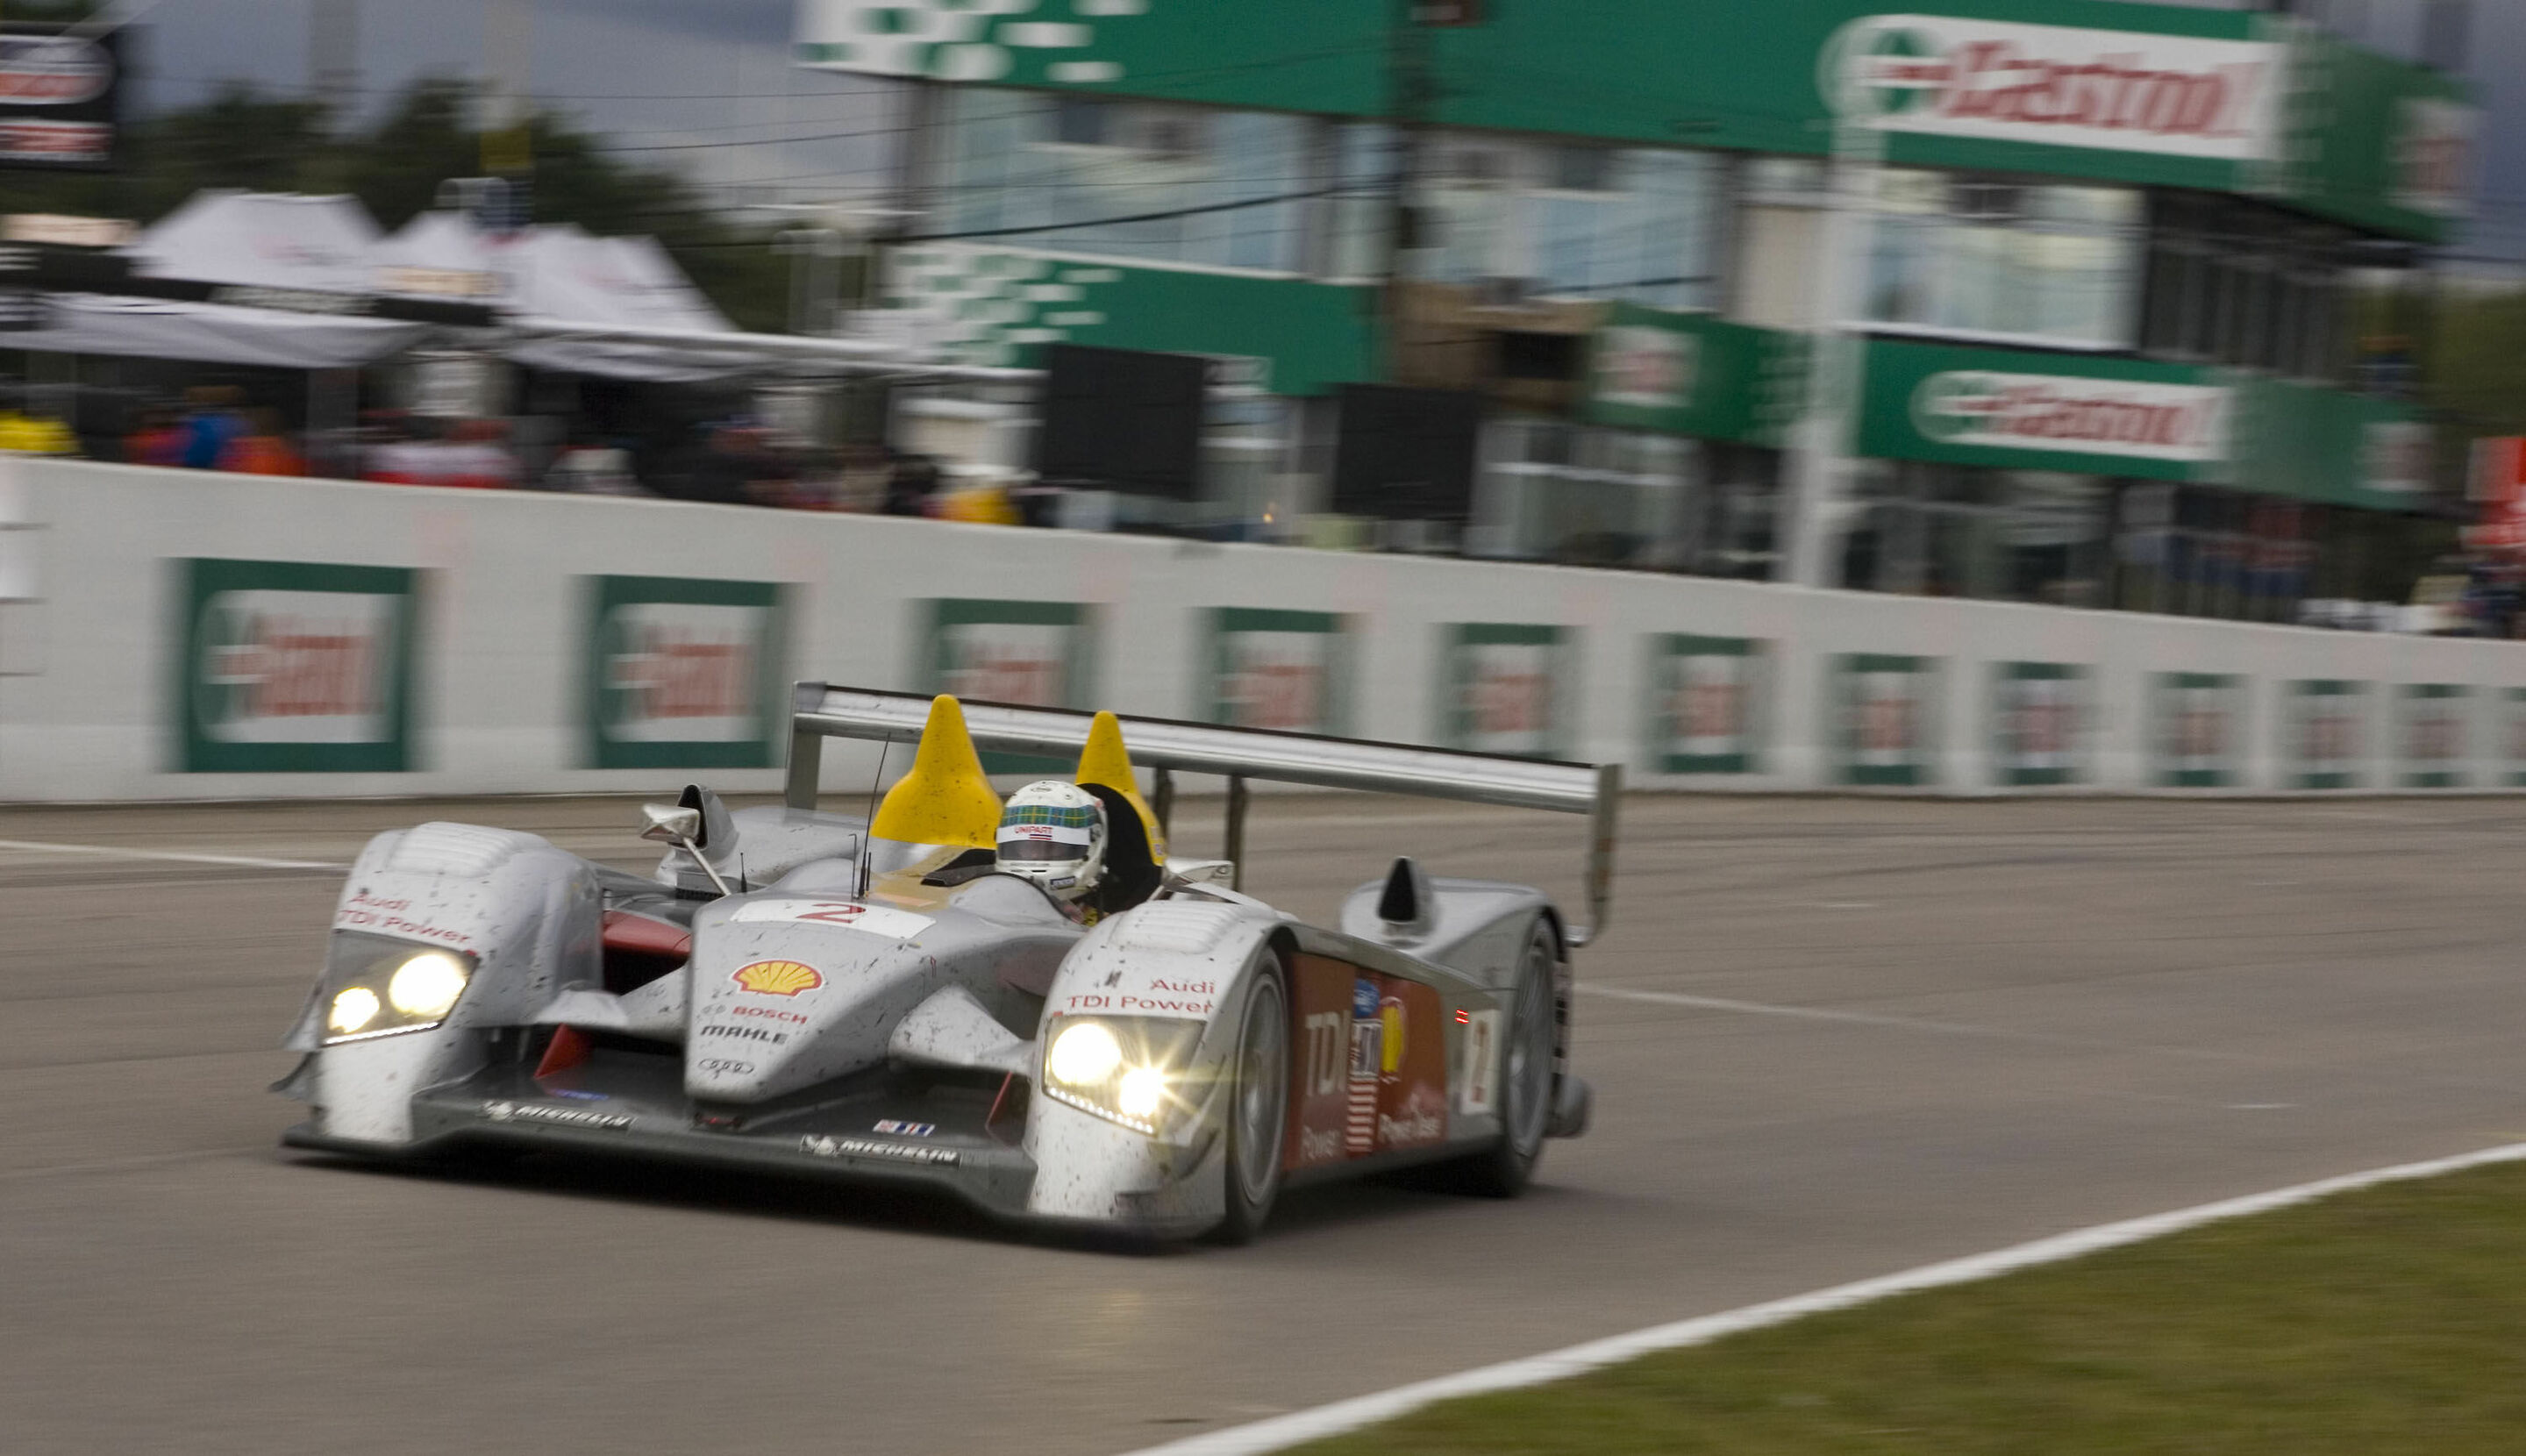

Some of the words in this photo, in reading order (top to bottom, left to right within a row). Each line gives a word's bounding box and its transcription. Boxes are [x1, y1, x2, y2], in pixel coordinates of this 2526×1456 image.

[1015, 824, 1053, 834] UNIPART
[348, 893, 411, 910] Audi
[796, 903, 867, 924] 2
[338, 909, 379, 924] TDI
[382, 916, 471, 942] Power
[1151, 978, 1215, 995] Audi
[731, 1005, 808, 1024] BOSCH
[1067, 995, 1111, 1009] TDI
[1121, 996, 1214, 1015] Power
[700, 1024, 788, 1045] MAHLE
[1305, 1010, 1352, 1096] TDI
[515, 1104, 632, 1127] MICHELIN
[839, 1139, 958, 1162] MICHELIN
